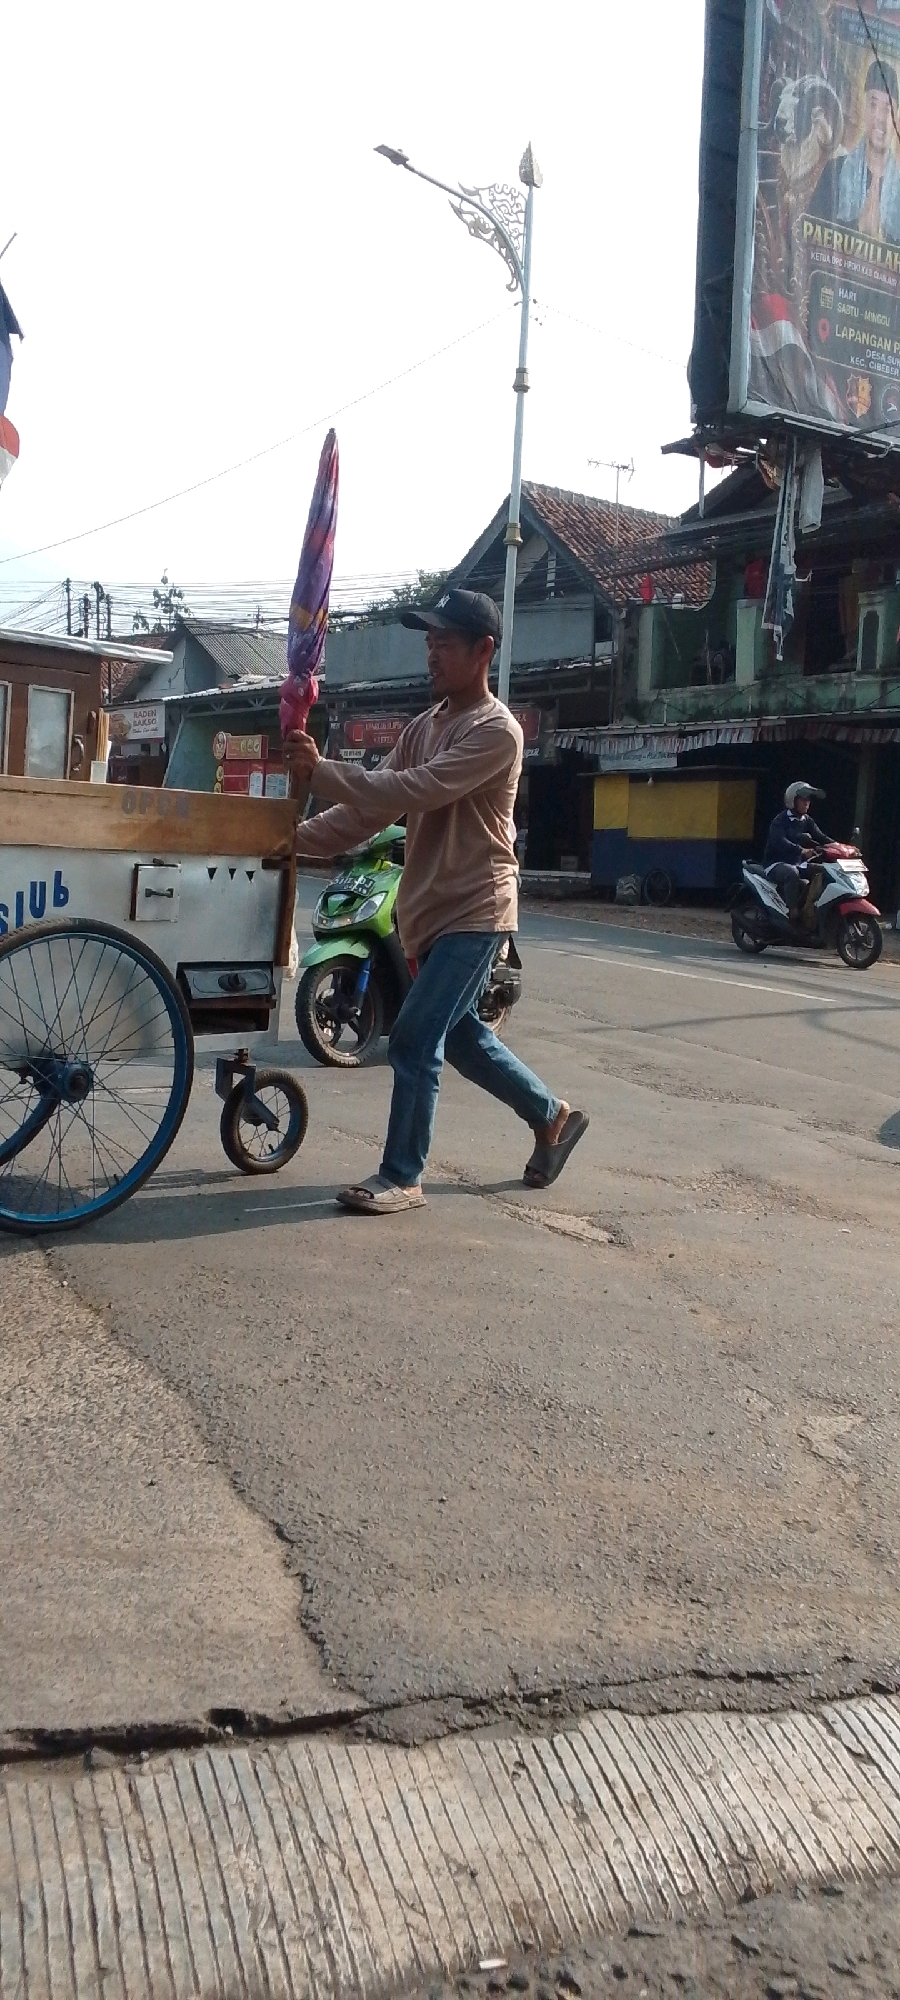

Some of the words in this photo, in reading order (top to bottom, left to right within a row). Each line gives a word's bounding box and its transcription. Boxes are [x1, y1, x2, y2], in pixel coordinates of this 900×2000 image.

[810, 251, 831, 264] KETUA
[838, 287, 857, 302] HARI
[836, 302, 859, 318] SABTU
[864, 310, 891, 327] MINGGU
[835, 324, 892, 352] LAPANGAN
[893, 341, 900, 355] P
[865, 349, 886, 363] DESA
[850, 355, 867, 368] KEC.
[868, 361, 900, 376] CIBEBER
[133, 709, 157, 719] RADEN
[133, 718, 157, 727] BAKSO
